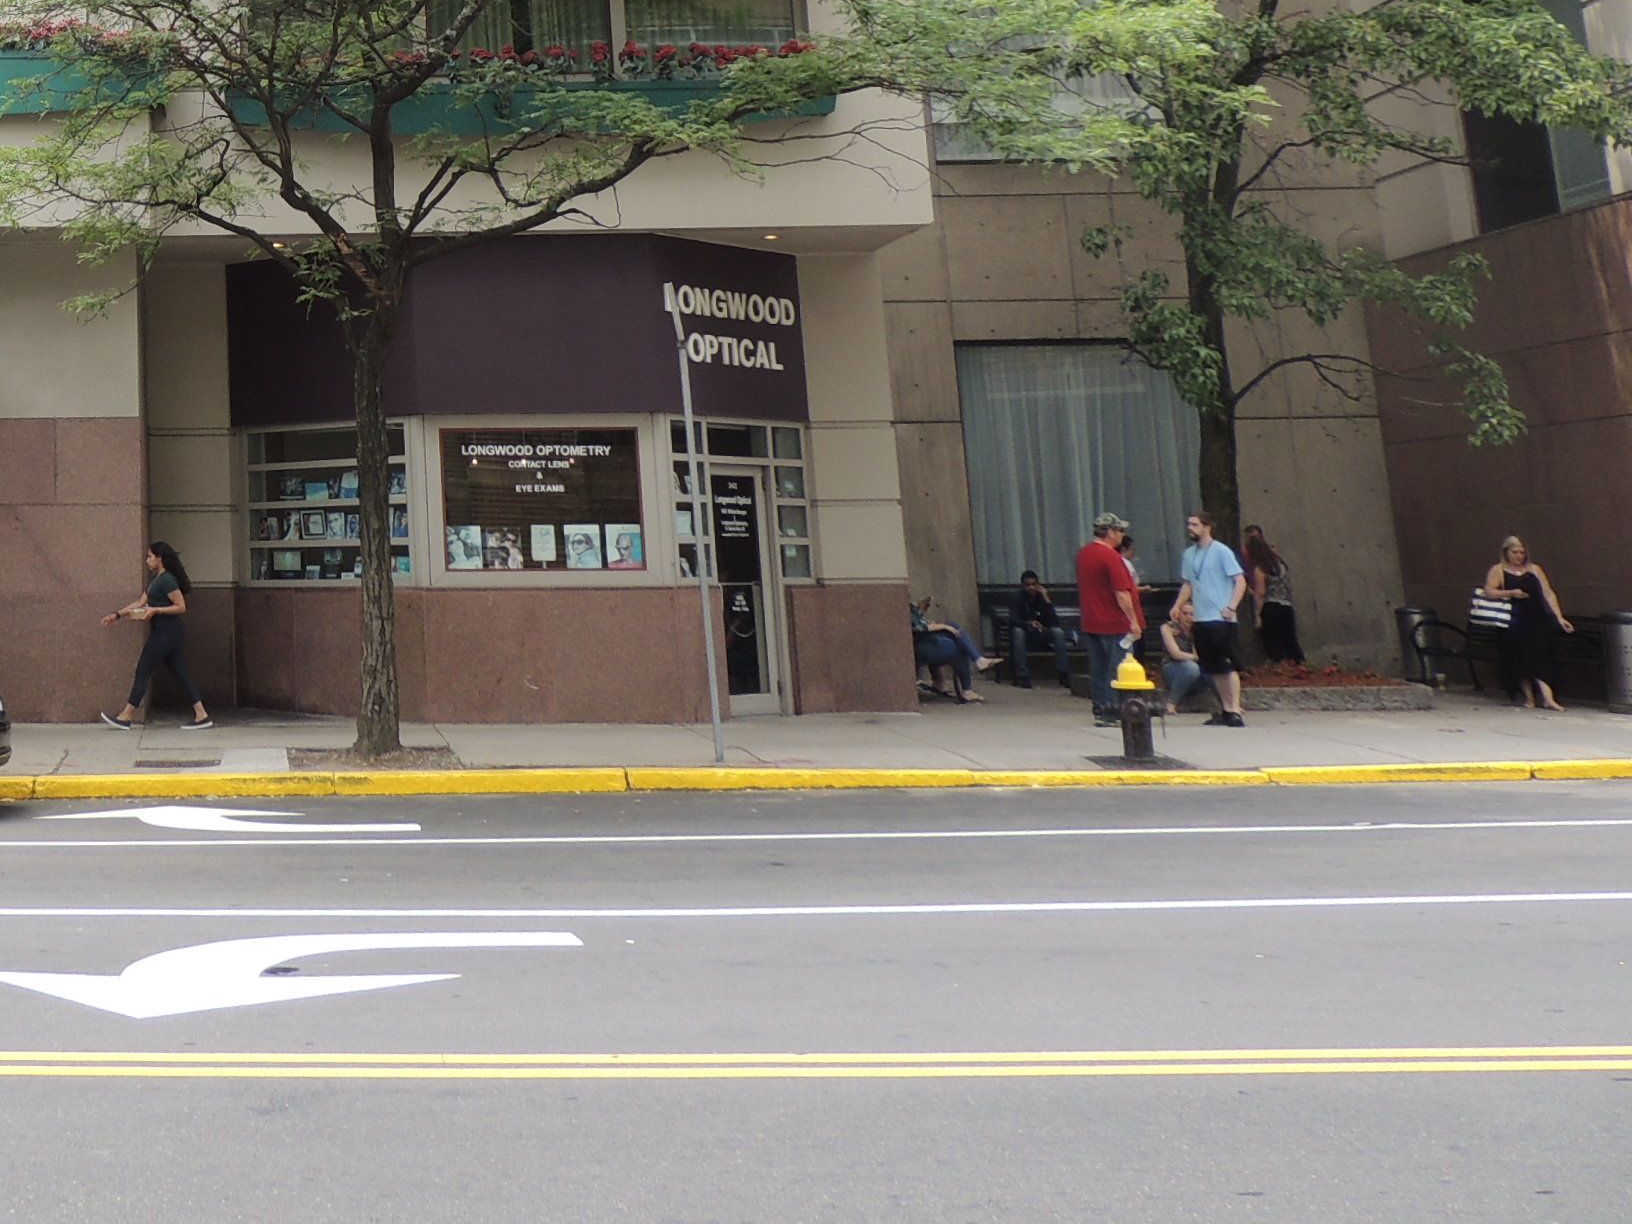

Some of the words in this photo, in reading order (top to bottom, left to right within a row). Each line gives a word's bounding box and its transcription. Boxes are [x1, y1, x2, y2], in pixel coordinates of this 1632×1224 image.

[663, 282, 796, 326] LONGWOOD
[687, 332, 784, 370] OPTICAL
[461, 445, 533, 456] LONGWOOD
[536, 445, 611, 456] OPTOMETRY
[508, 460, 546, 469] CONTACT
[547, 460, 570, 469] LENS
[515, 484, 533, 493] EYE
[534, 484, 565, 493] EXAMS
